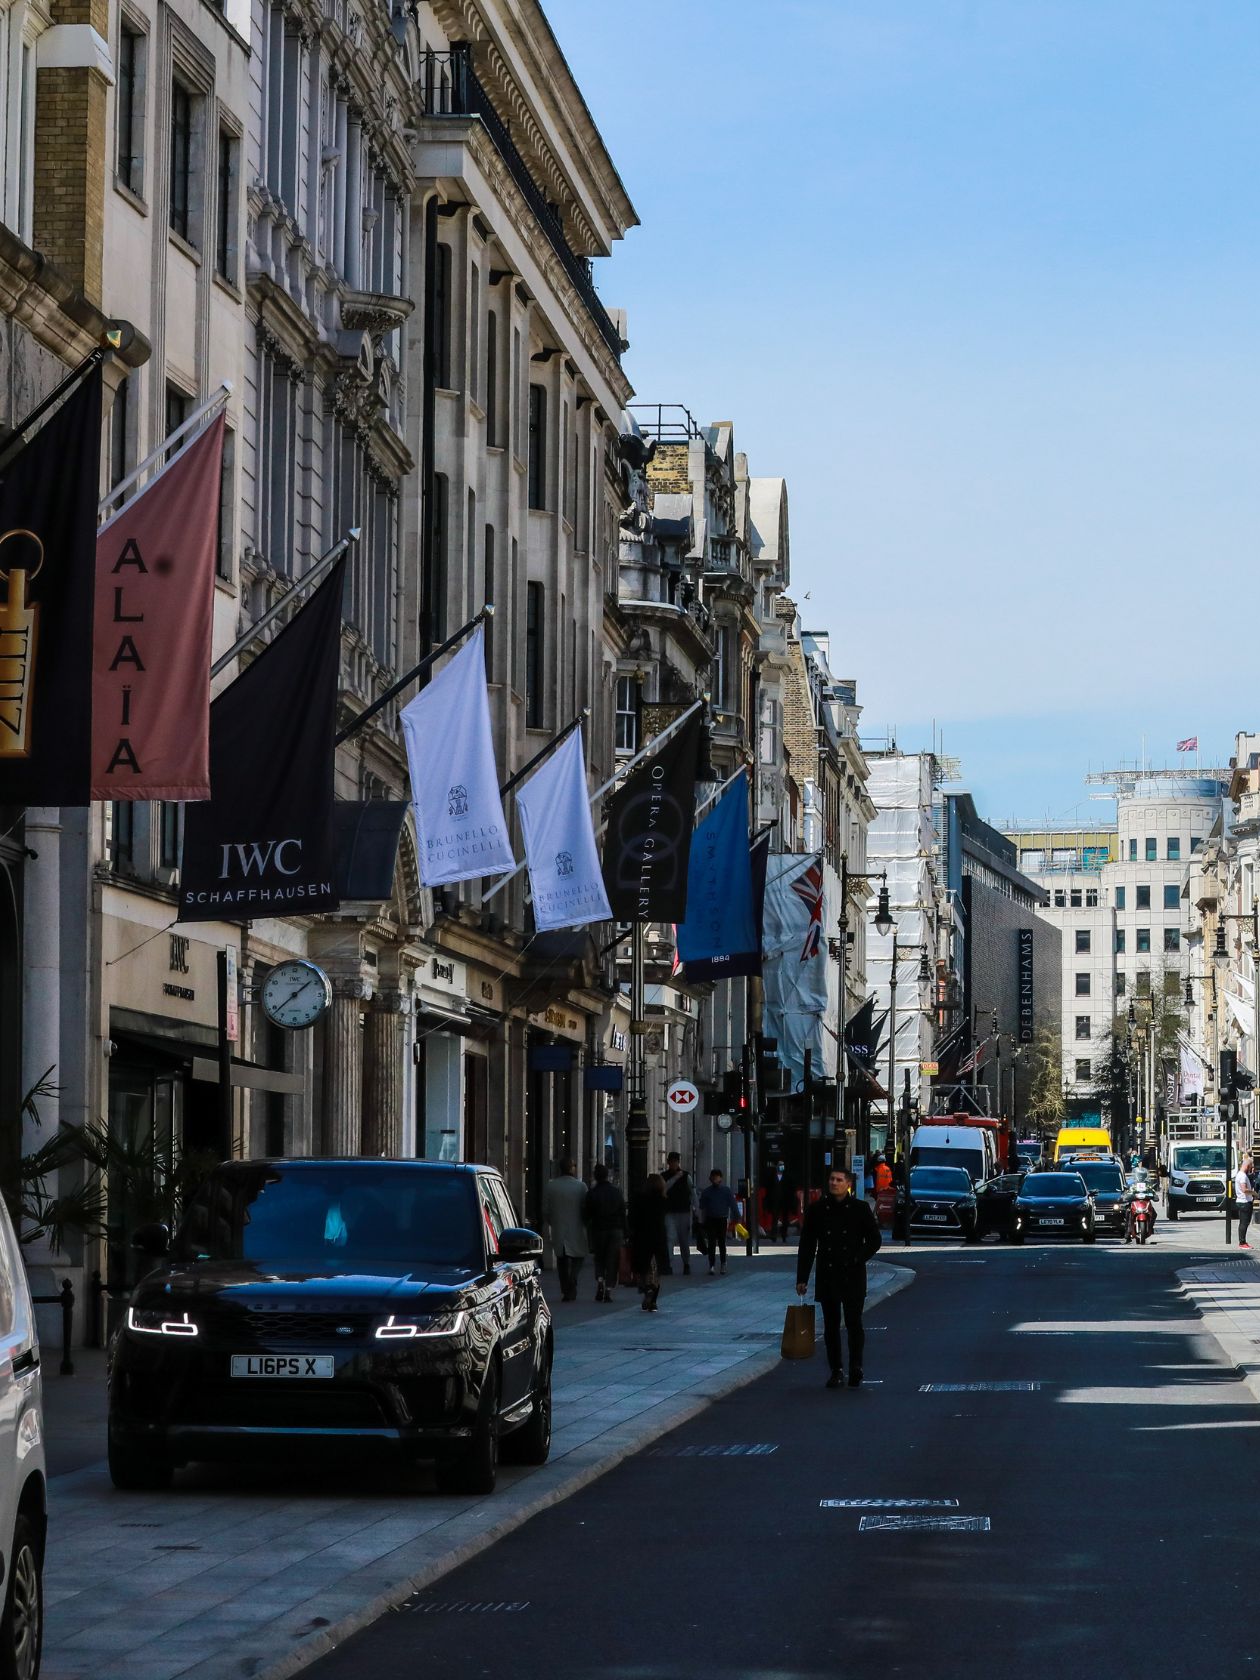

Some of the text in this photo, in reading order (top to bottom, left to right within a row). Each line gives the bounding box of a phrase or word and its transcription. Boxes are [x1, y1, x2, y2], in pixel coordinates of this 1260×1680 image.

[105, 538, 148, 774] ALAÏA
[427, 824, 498, 849] BRUNELLO
[428, 839, 502, 863] CUCINELLI
[638, 766, 665, 918] OPERA GALLERY
[218, 839, 303, 879] IWC
[185, 882, 332, 904] SCHAFFHAUSEN
[539, 882, 599, 902] BRUNELLO
[1021, 931, 1032, 1040] DEBENHAMS
[1167, 1073, 1175, 1106] ZEGNA
[305, 1358, 316, 1375] X
